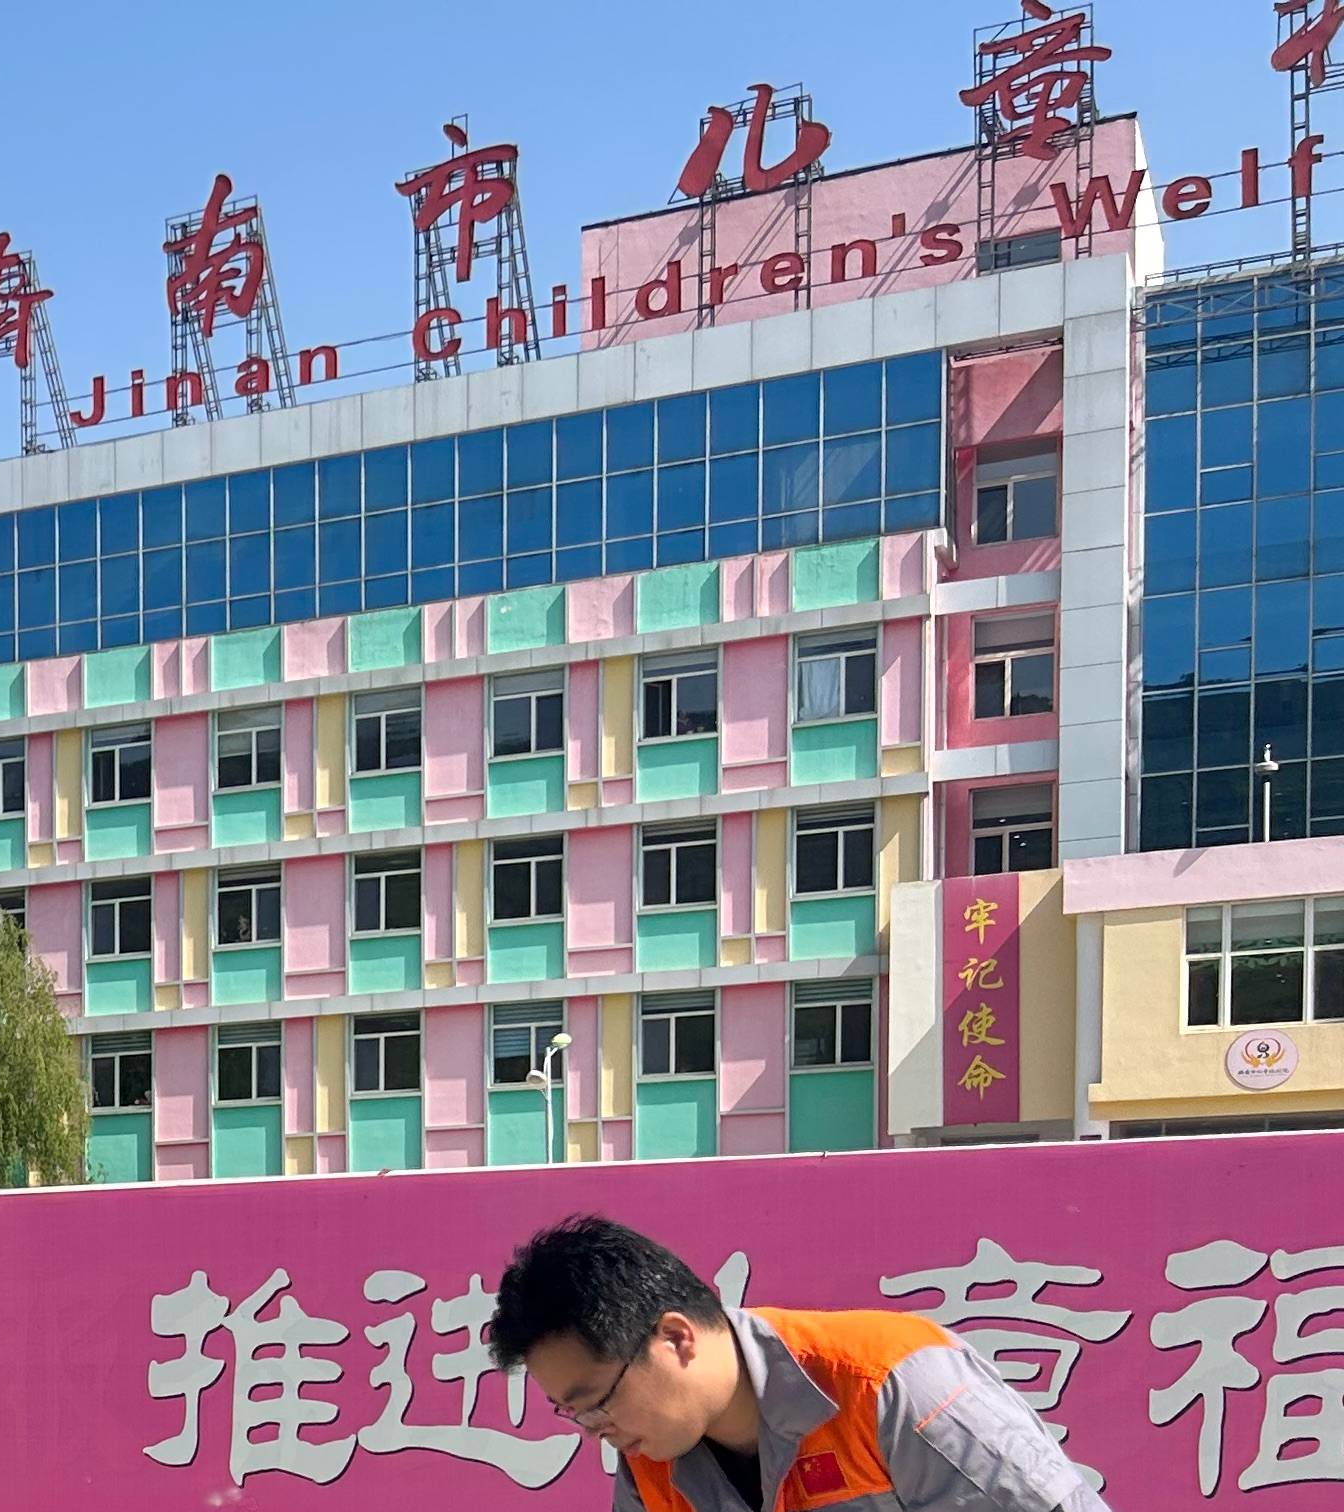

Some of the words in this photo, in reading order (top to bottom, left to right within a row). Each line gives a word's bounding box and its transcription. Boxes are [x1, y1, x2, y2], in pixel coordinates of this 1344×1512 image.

[69, 343, 341, 427] Jinan
[412, 213, 964, 361] Children's
[1050, 134, 1324, 237] Welf
[957, 897, 1006, 1101] 牢记使命
[142, 1238, 1344, 1496] 推进童福
